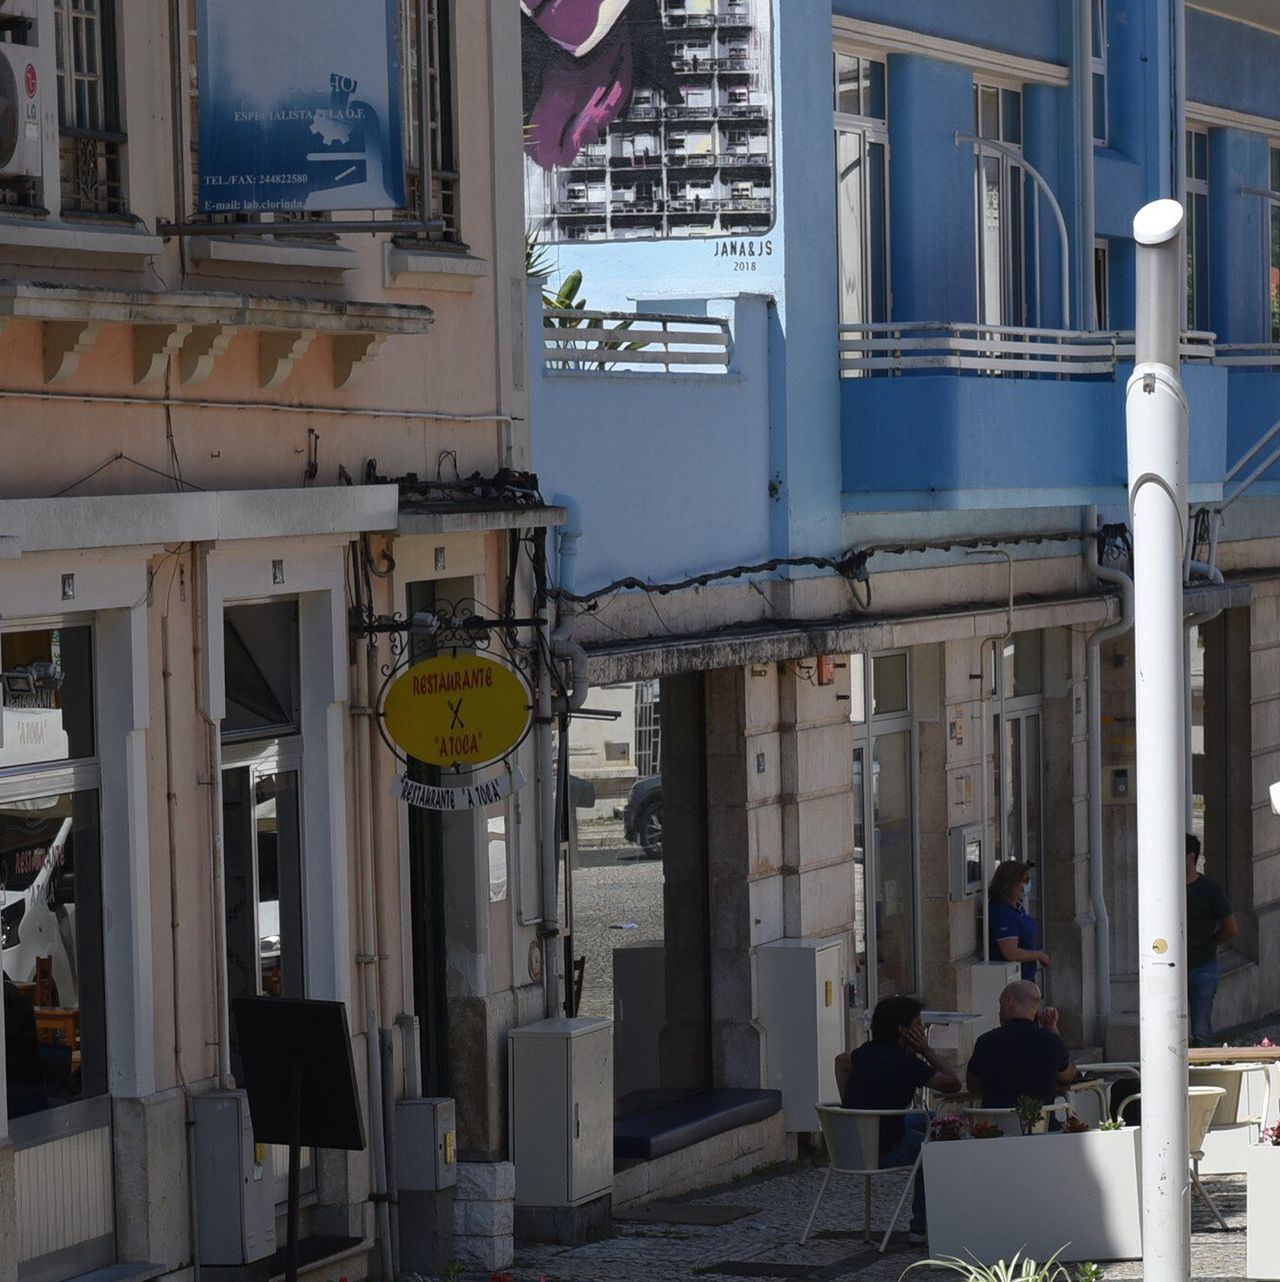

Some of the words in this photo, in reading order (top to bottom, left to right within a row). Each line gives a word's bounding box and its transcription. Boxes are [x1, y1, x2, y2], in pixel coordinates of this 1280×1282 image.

[26, 103, 37, 119] LG
[204, 175, 257, 186] TEL./FAX:
[258, 173, 308, 185] 244822580
[713, 240, 773, 257] JANA&JS
[733, 261, 757, 272] 2018
[412, 667, 493, 696] RESTAURANTE
